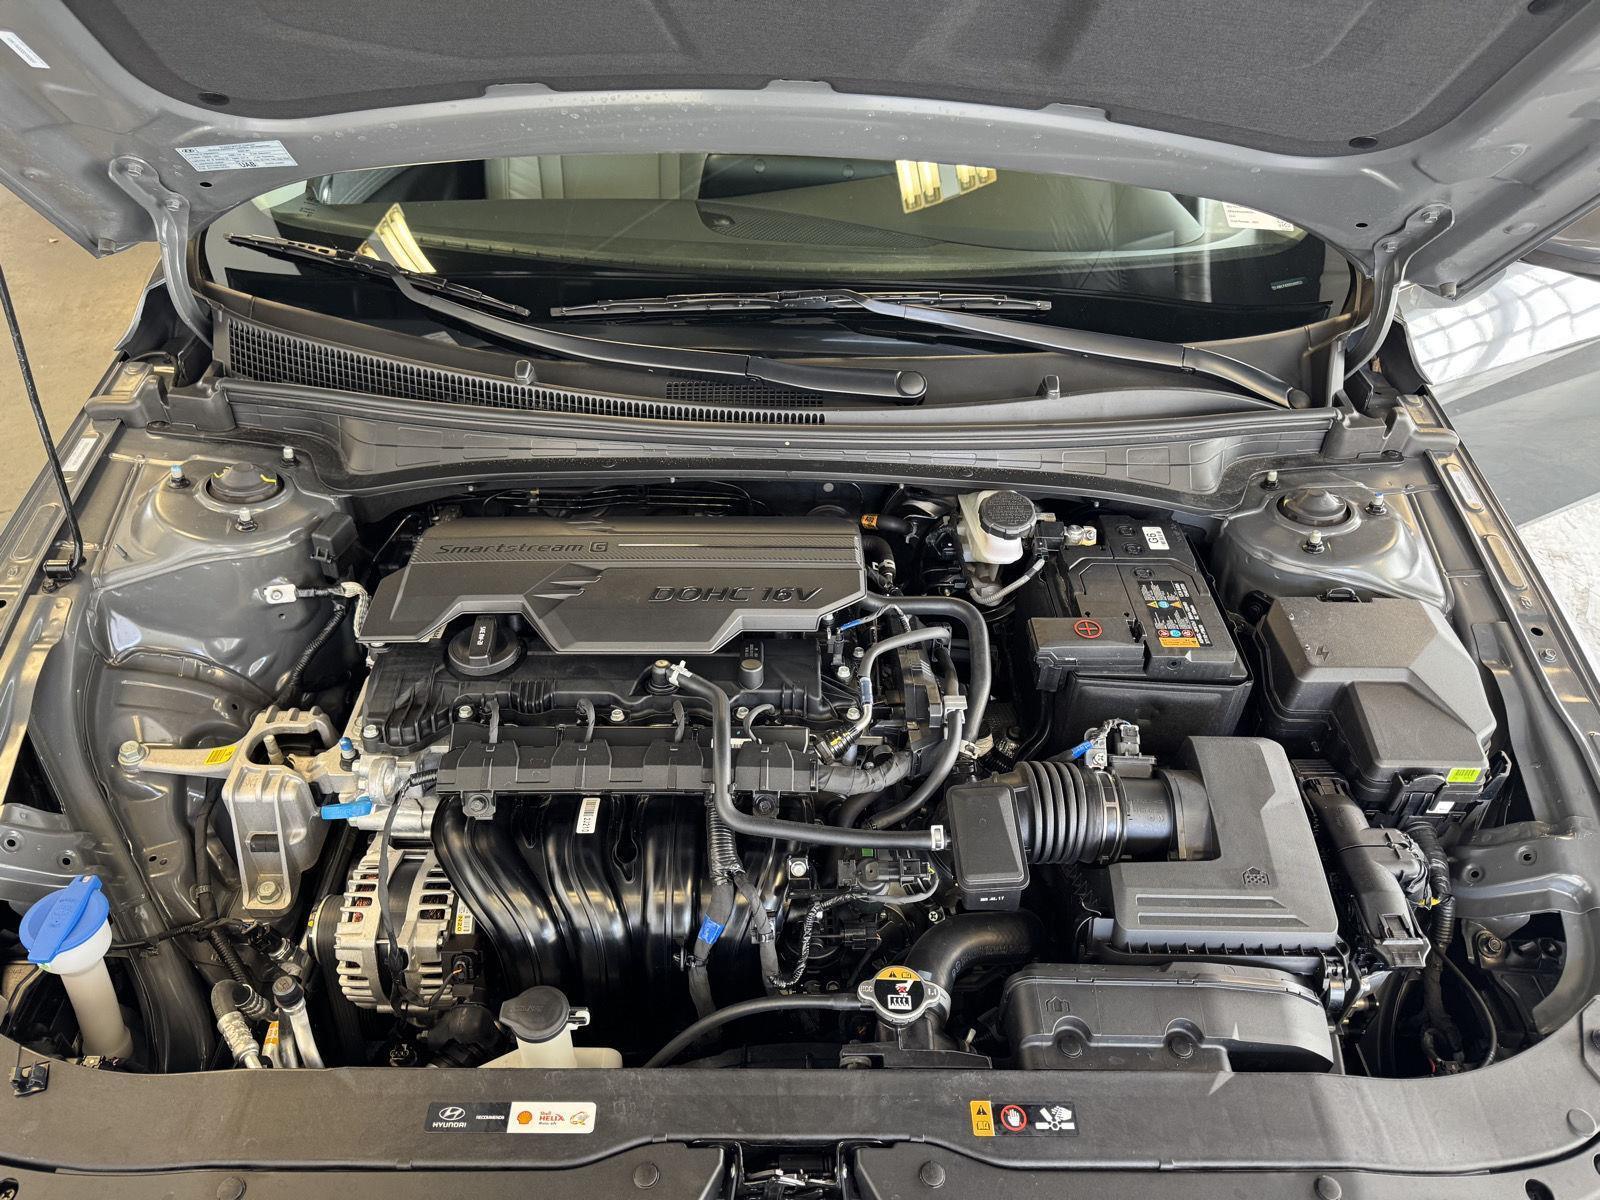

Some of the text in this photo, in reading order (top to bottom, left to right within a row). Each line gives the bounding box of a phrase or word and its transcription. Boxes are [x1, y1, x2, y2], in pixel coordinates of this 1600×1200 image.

[1146, 532, 1159, 544] G6
[434, 543, 608, 555] Smartstream G
[649, 585, 823, 602] DOHC 16V
